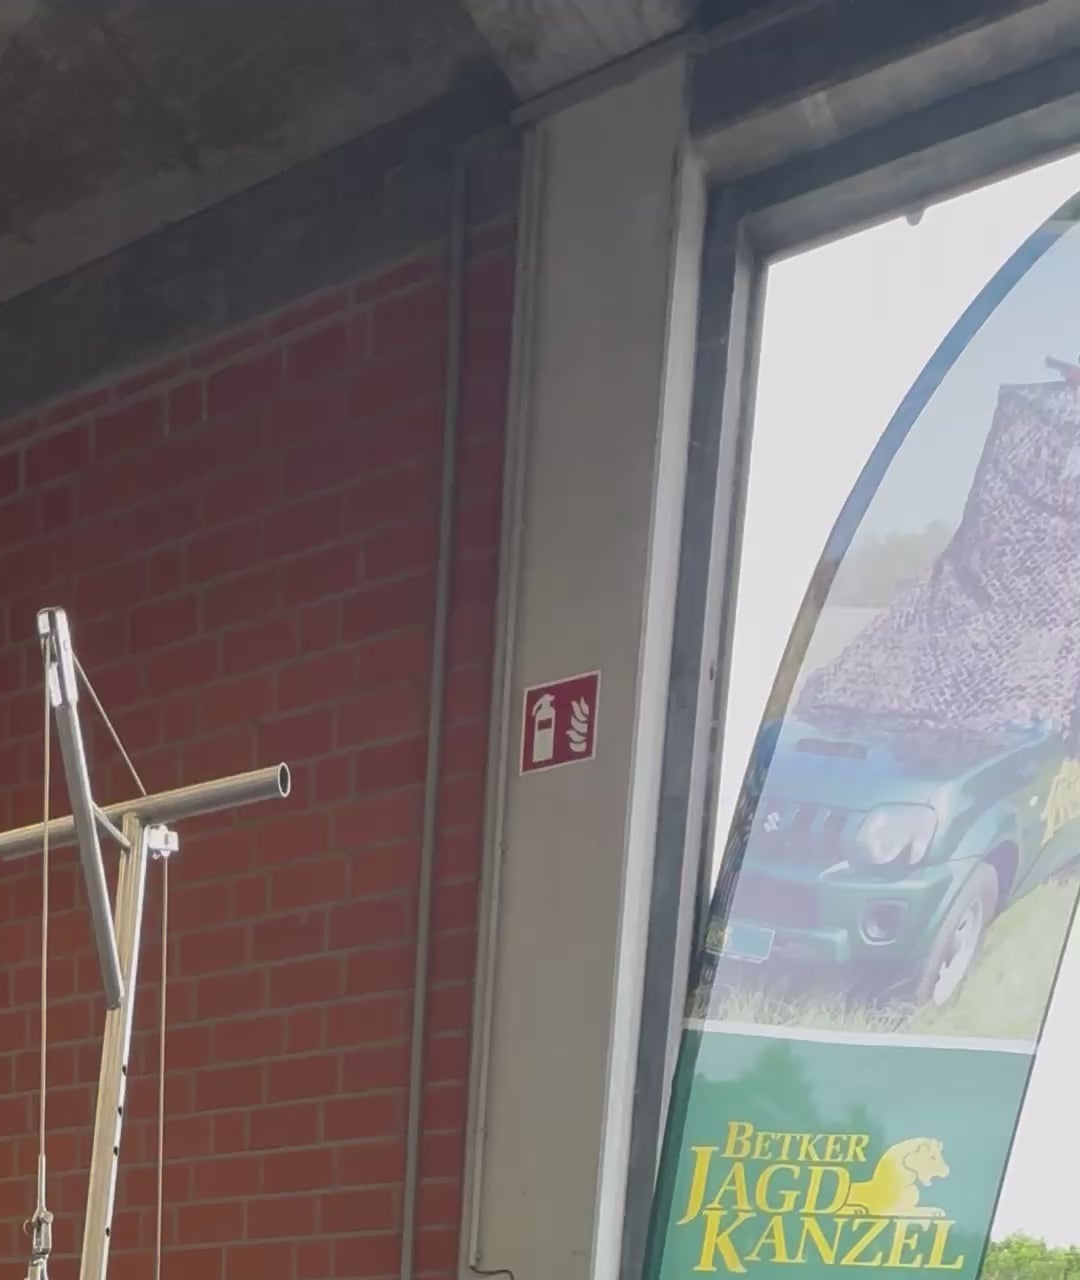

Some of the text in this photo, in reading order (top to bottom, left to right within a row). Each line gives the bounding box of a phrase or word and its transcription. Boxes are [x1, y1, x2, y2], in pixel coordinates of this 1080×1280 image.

[721, 1121, 870, 1163] BETKER
[676, 1146, 852, 1225] JAGD
[693, 1210, 965, 1273] KANZEL
